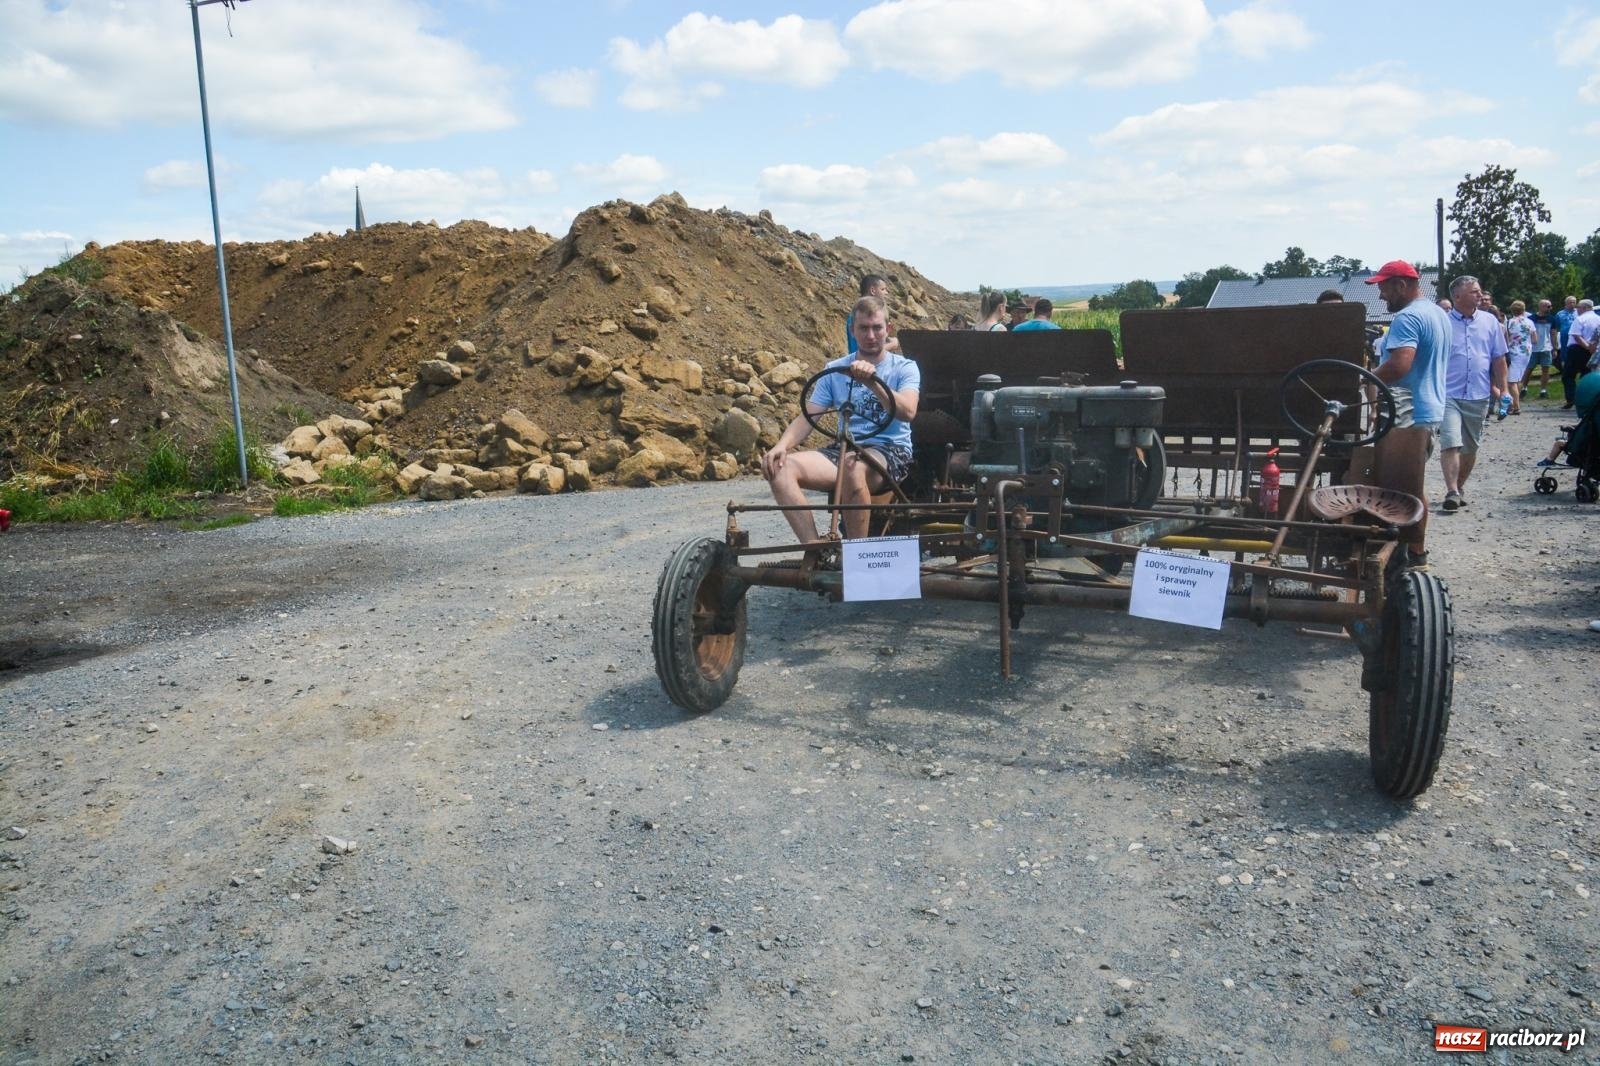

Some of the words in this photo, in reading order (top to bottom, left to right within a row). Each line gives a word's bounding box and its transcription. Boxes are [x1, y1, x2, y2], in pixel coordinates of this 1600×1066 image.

[858, 551, 899, 560] SCHMOTZER
[1144, 560, 1167, 570] 100%
[1169, 563, 1214, 578] oryginalny
[1161, 575, 1197, 587] sprawny
[1158, 587, 1191, 598] siewnik
